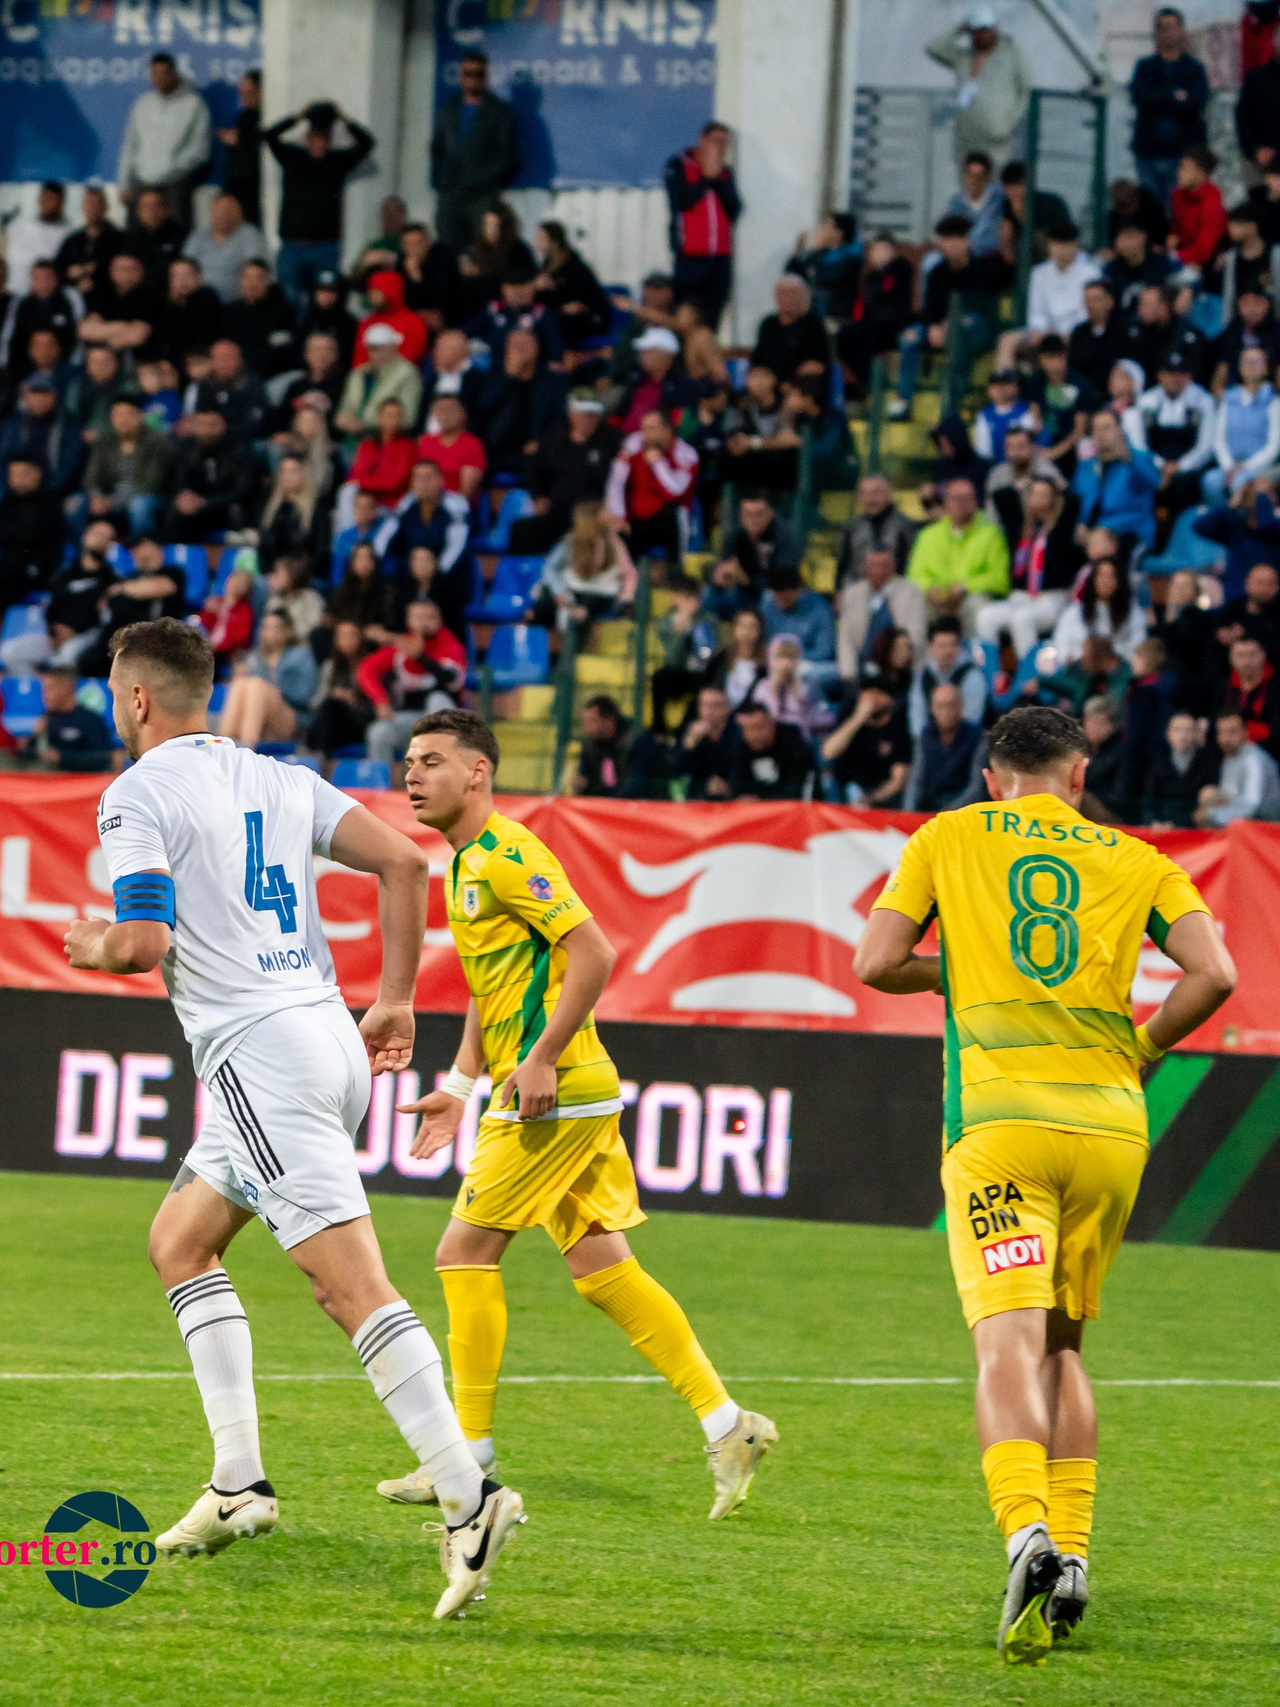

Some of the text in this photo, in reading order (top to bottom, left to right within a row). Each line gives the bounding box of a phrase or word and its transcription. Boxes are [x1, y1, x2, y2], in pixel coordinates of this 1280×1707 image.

[244, 810, 299, 935] 4
[1007, 853, 1081, 989] 8
[256, 946, 313, 974] MIRON
[53, 1049, 175, 1163] DE
[967, 1181, 1025, 1217] APA
[970, 1206, 1021, 1241] DIN
[983, 1237, 1041, 1273] NOY
